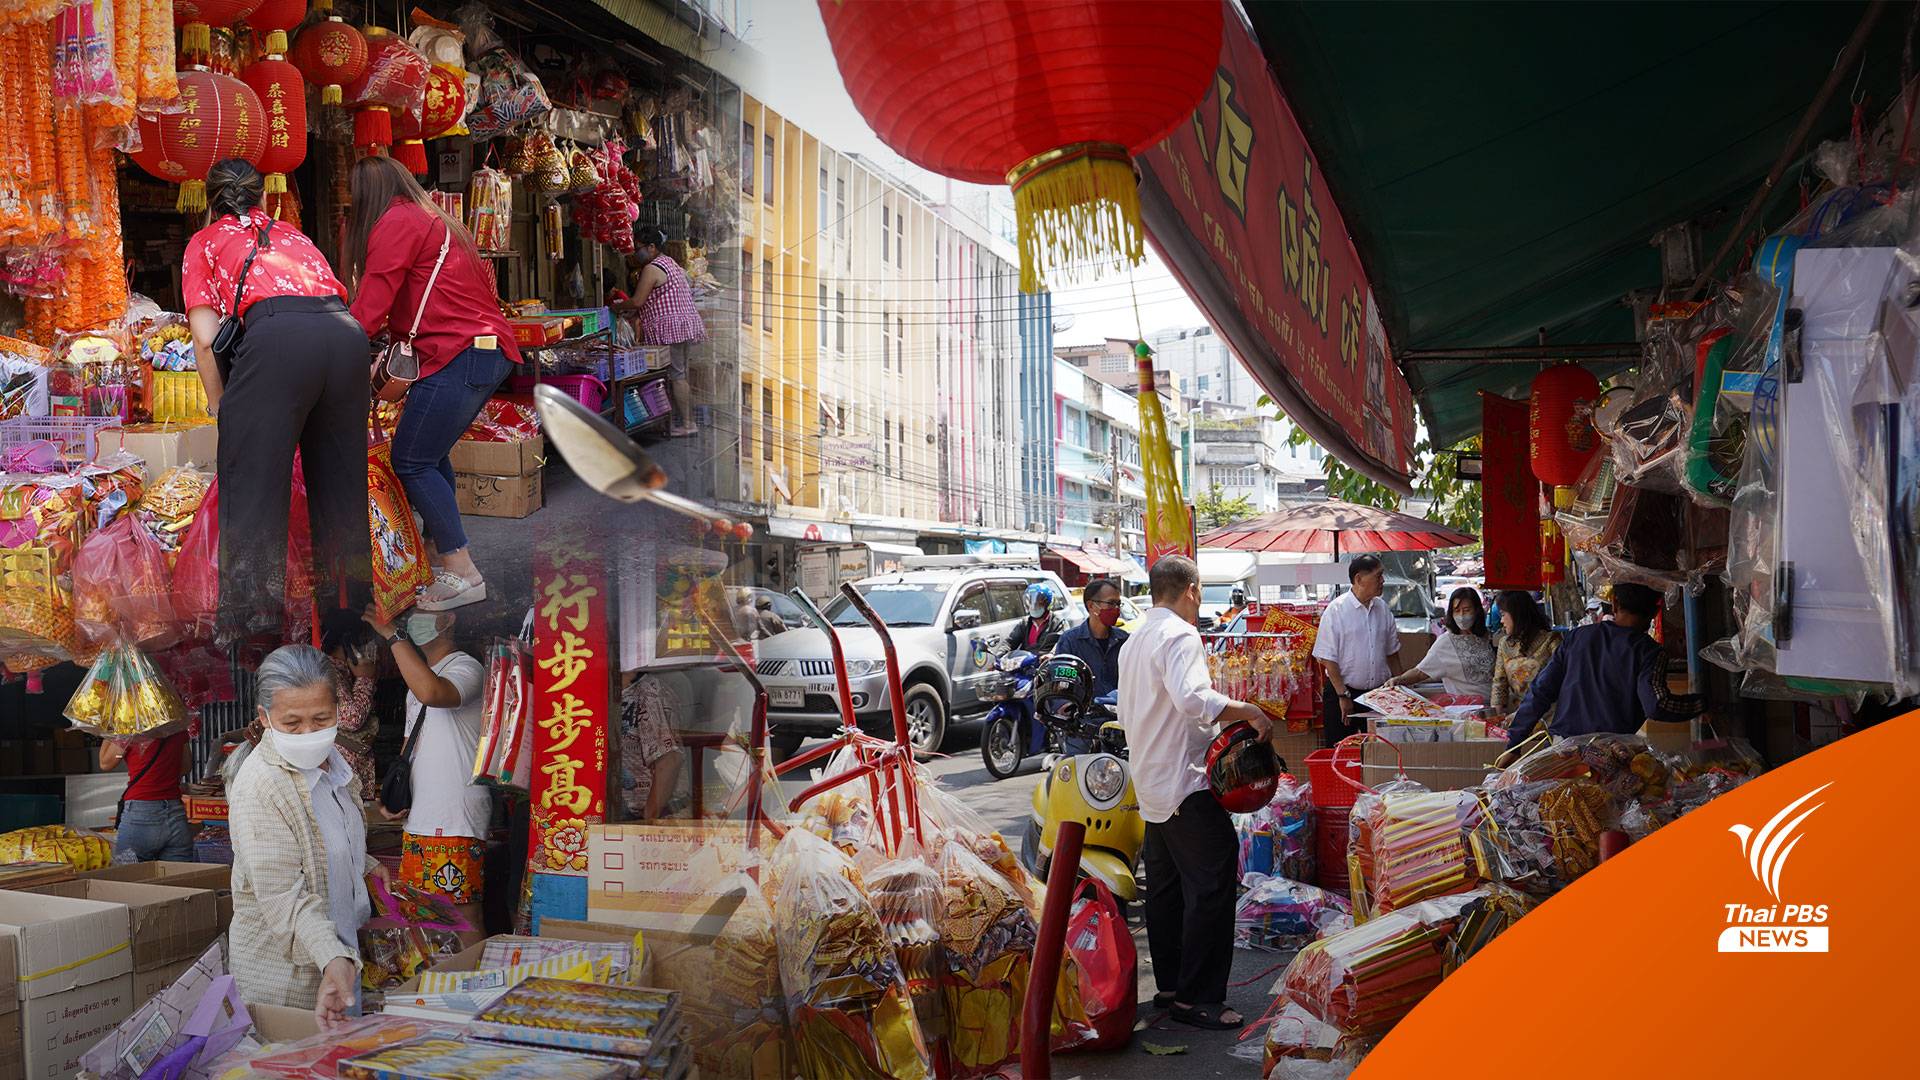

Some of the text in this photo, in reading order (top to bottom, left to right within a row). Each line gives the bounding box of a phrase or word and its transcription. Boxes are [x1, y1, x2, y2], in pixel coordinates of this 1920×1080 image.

[266, 82, 291, 148] 恭喜發財
[1056, 667, 1077, 678] 1386
[639, 861, 689, 871] รถกระบะ
